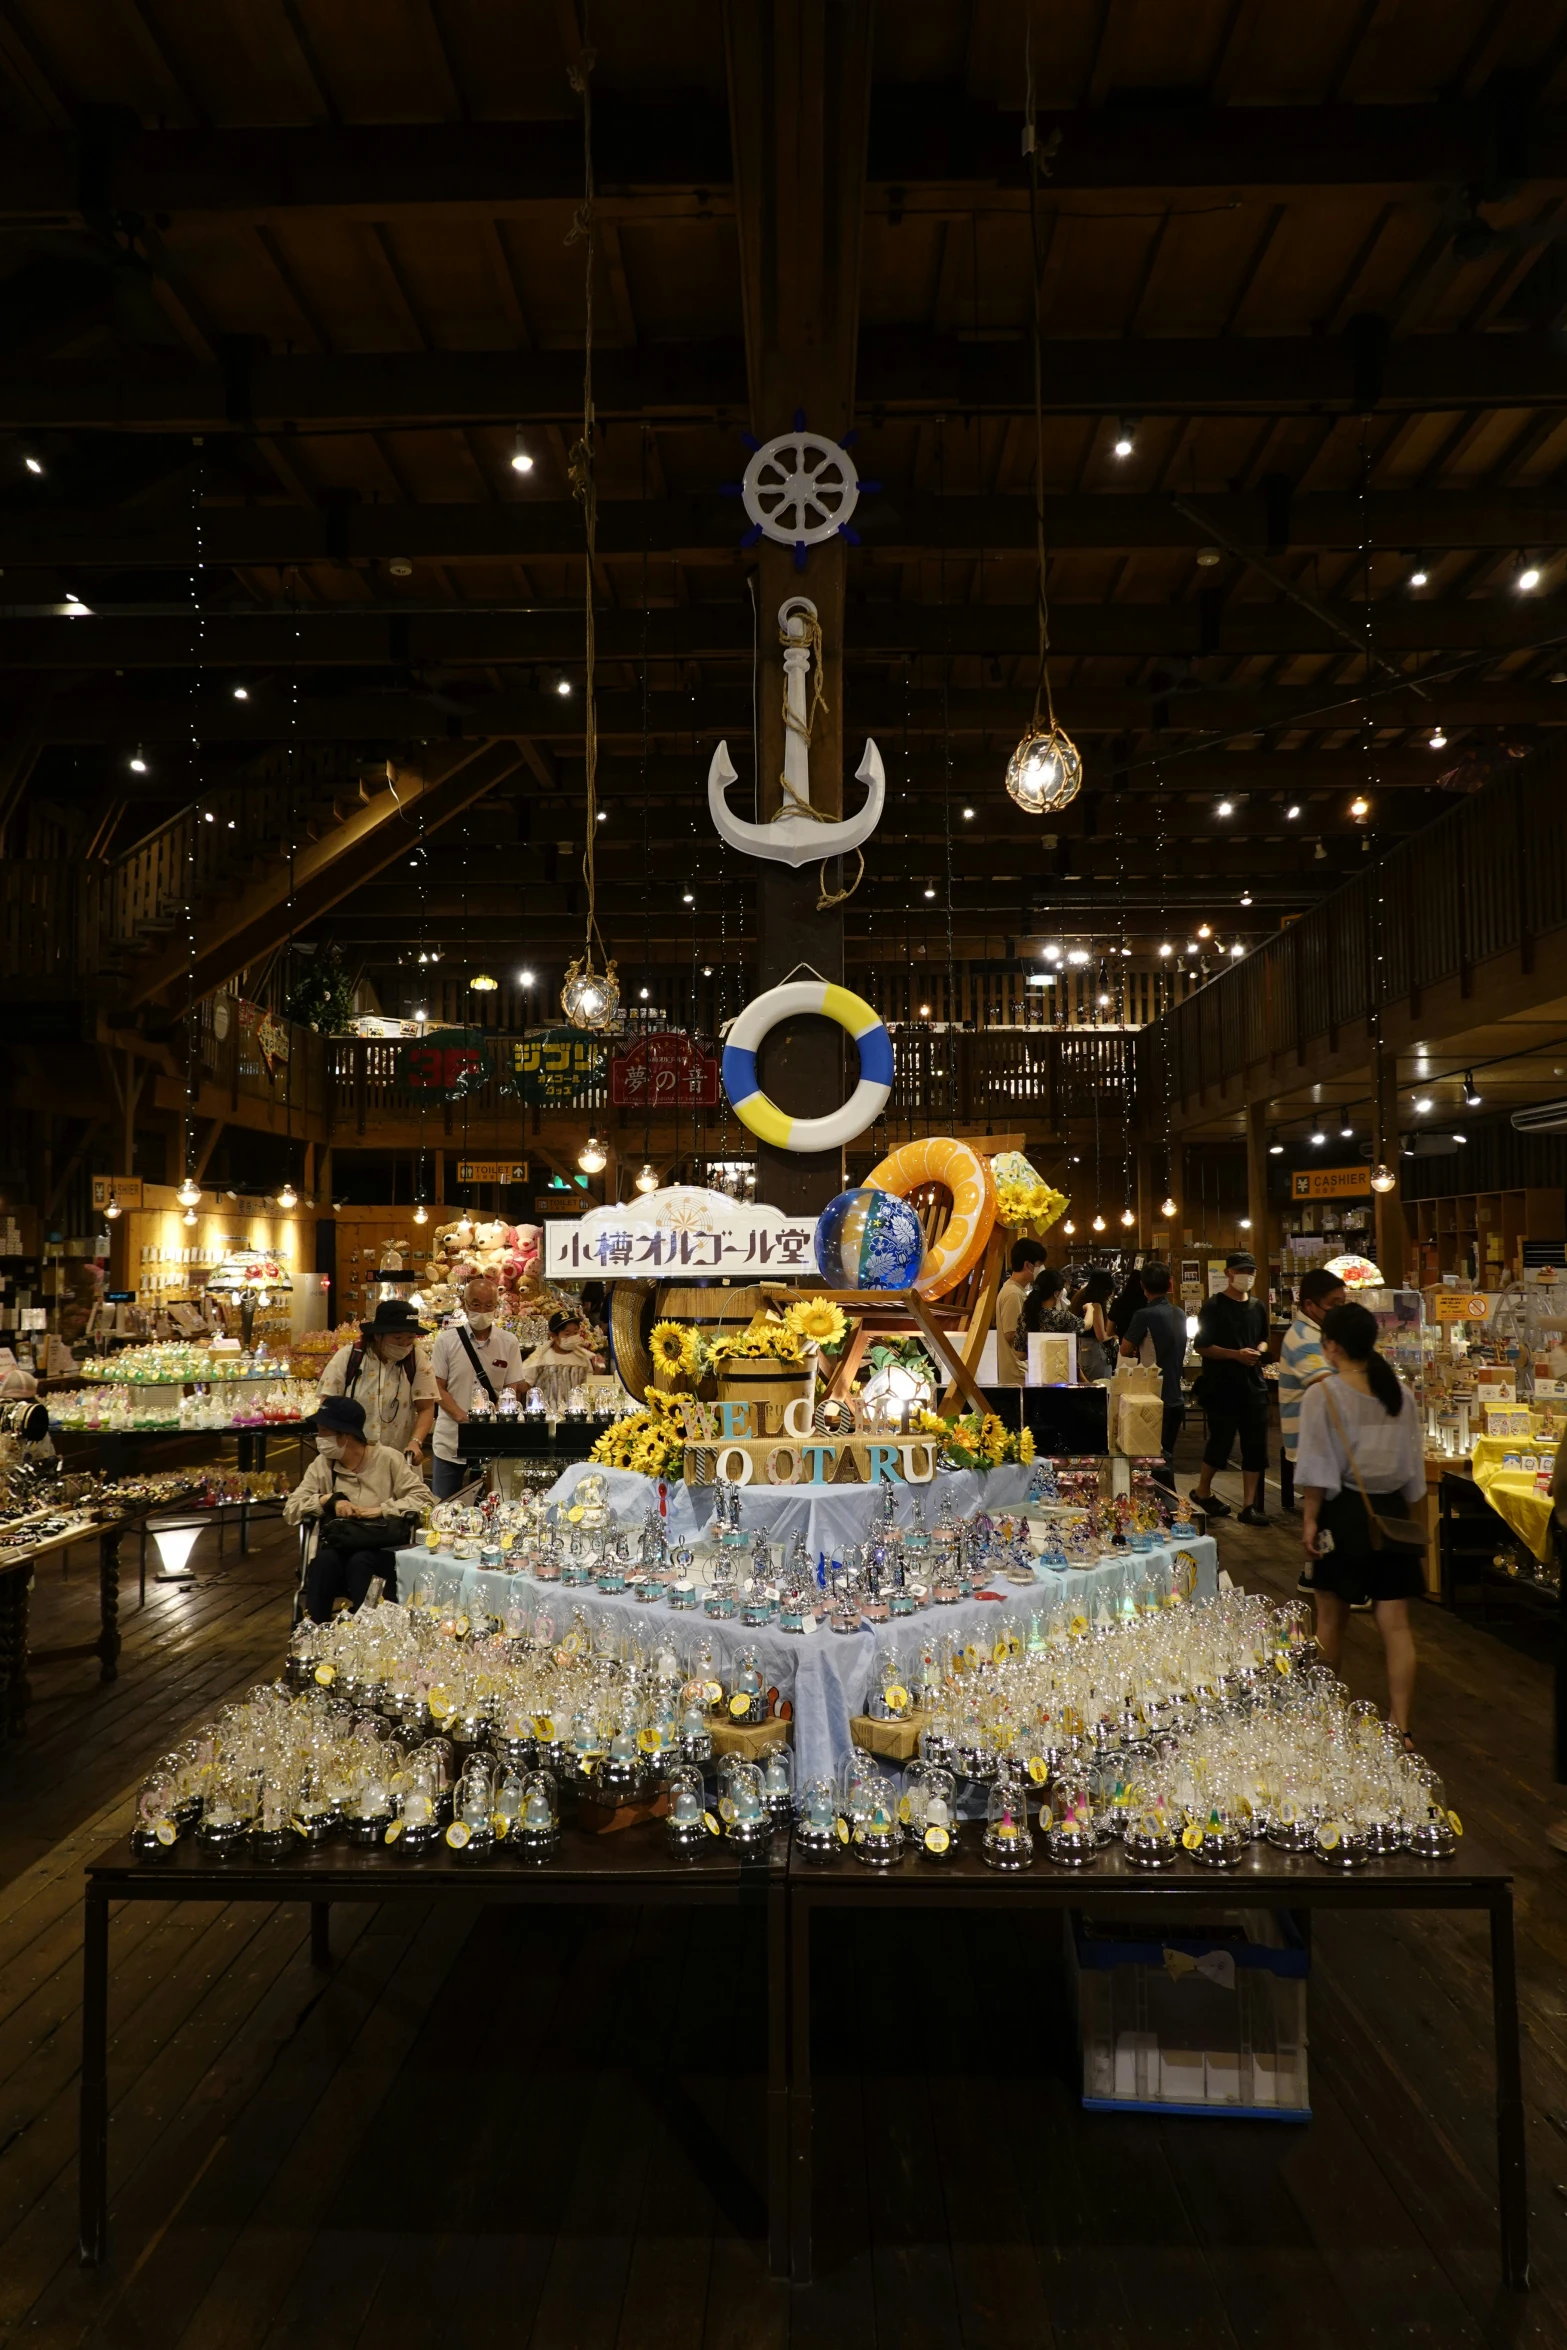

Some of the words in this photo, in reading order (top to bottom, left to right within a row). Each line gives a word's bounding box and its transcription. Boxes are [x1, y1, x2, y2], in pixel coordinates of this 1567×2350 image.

[408, 1048, 481, 1088] 3F
[513, 1042, 598, 1072] ジブリ
[537, 1074, 581, 1084] オルゴール
[545, 1085, 573, 1096] グッズ
[624, 1064, 708, 1094] 夢の音
[474, 1166, 510, 1174] TOILET
[1314, 1173, 1366, 1186] CASHIER
[557, 1229, 811, 1267] 小樽オルゴール堂
[560, 1311, 571, 1320] B
[677, 1396, 929, 1442] WELCOME
[683, 1445, 754, 1488] TO
[766, 1442, 938, 1486] OTARU
